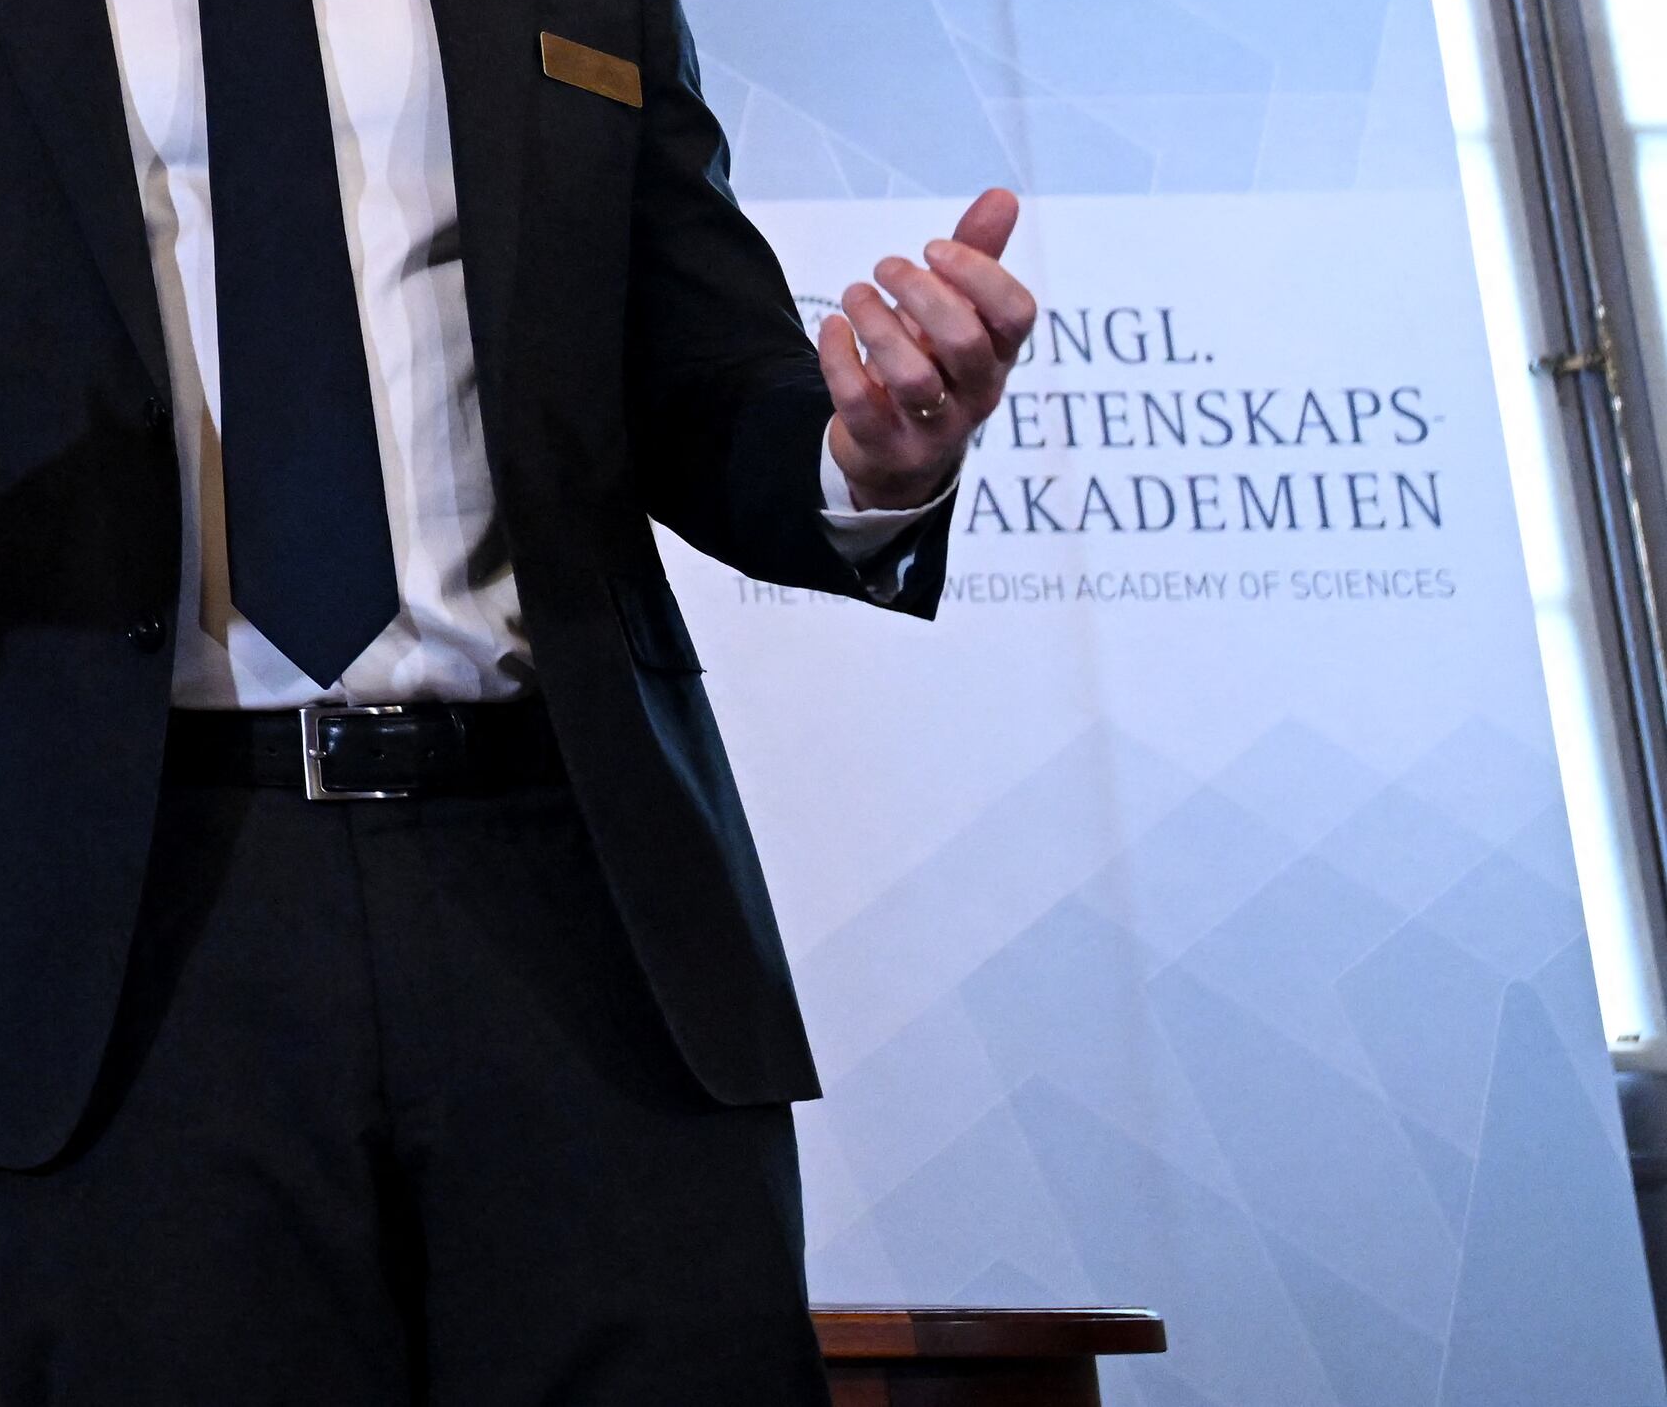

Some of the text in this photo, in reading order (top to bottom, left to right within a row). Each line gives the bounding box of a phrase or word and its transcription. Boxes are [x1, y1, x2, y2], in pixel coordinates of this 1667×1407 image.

[1017, 308, 1214, 366] NGL.
[965, 473, 1443, 534] AKADEMIEN
[943, 572, 1064, 604] WEDISH
[1074, 571, 1228, 603] ACADEMY
[1238, 569, 1281, 601] OF
[1290, 567, 1458, 601] SCIENCES
